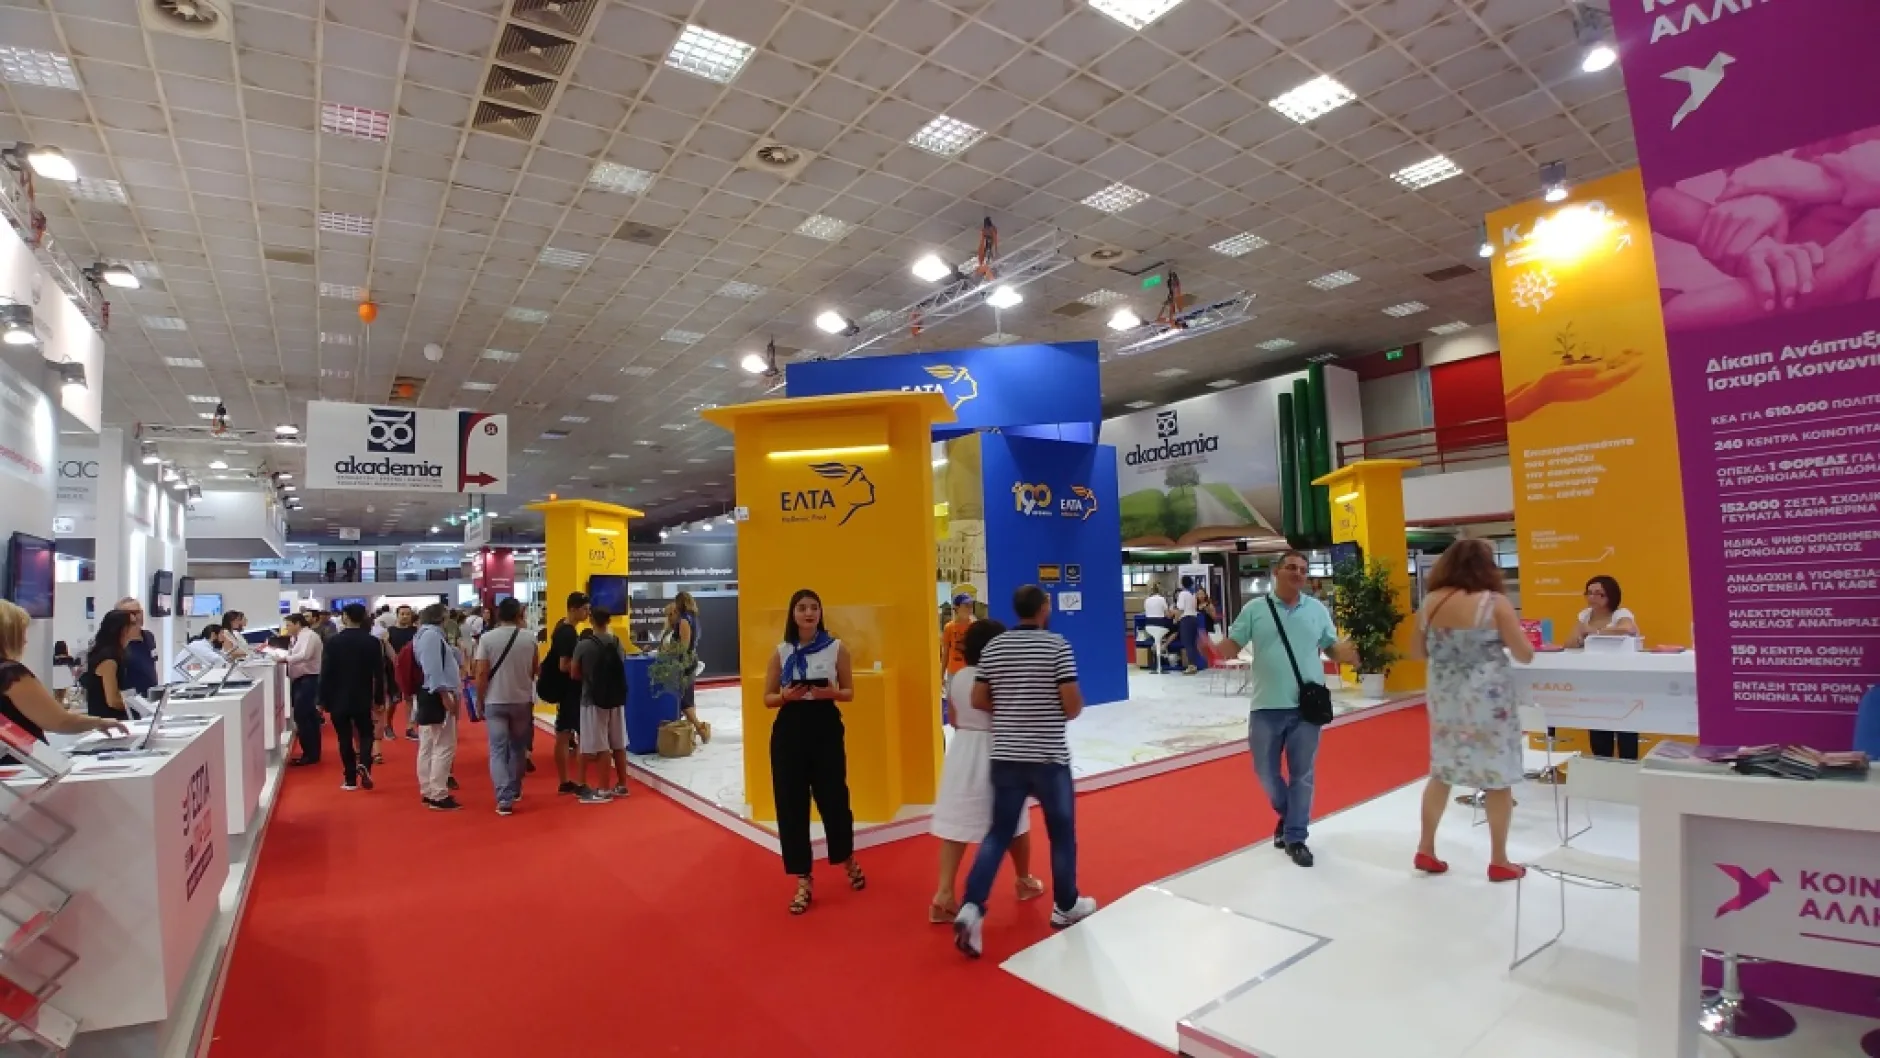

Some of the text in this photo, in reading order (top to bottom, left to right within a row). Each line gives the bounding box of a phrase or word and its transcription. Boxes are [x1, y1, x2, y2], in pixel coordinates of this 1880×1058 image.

[1650, 0, 1769, 44] ΑΛΛ
[1705, 351, 1775, 374] Δίκαιη
[1706, 365, 1781, 392] Ισχυρή
[1711, 414, 1738, 426] ΚΕΑ
[1740, 411, 1763, 422] ΓΙΑ
[1765, 399, 1829, 419] 610.000
[1125, 432, 1220, 466] akademia
[1746, 433, 1798, 447] ΚΕΝΤΡΑ
[335, 455, 443, 477] akademia
[1768, 461, 1777, 471] 1
[1779, 453, 1848, 470] ΦΟΡΕΑΣ
[1851, 452, 1875, 463] ΓΙΑ
[1719, 477, 1734, 487] ΤΑ
[1737, 469, 1818, 486] ΠΡΟΝΟΙΑΚΑ
[781, 489, 836, 511] ΕΛΤΑ
[1720, 499, 1780, 513] 152.000
[1784, 495, 1827, 508] ΖΕΣΤΑ
[1721, 504, 1877, 524] ΓΕΥΜΑΤΑ ΚΑΘΗΜΕΡΙΝΑ
[1724, 541, 1862, 559] ΠΡΟΝΟΙΑΚΟ ΚΡΑΤΟΣ
[1726, 572, 1793, 583] ΑΝΑΔΟΧΗ
[1795, 571, 1805, 581] &
[1727, 579, 1877, 594] ΟΙΚΟΓΕΝΕΙΑ ΓΙΑ ΚΑΘΕ
[1728, 607, 1833, 618] ΗΛΕΚΤΡΟΝΙΚΟΣ
[1728, 618, 1794, 629] ΦΑΚΕΛΟΣ
[1730, 644, 1757, 655] 150
[1760, 646, 1813, 655] ΚΕΝΤΡΑ
[1732, 656, 1862, 667] ΓΙΑ ΗΛΙΚΙΩΜΕΝΟΥΣ
[1733, 681, 1785, 692] ΕΝΤΑΞΗ
[1788, 682, 1818, 692] ΤΩΝ
[1821, 682, 1863, 693] ΡΟΜΑ
[1734, 692, 1861, 704] ΚΟΙΝΩΝΙΑ ΚΑΙ ΤΗΝ
[1800, 870, 1880, 899] ΚΟΙΝ
